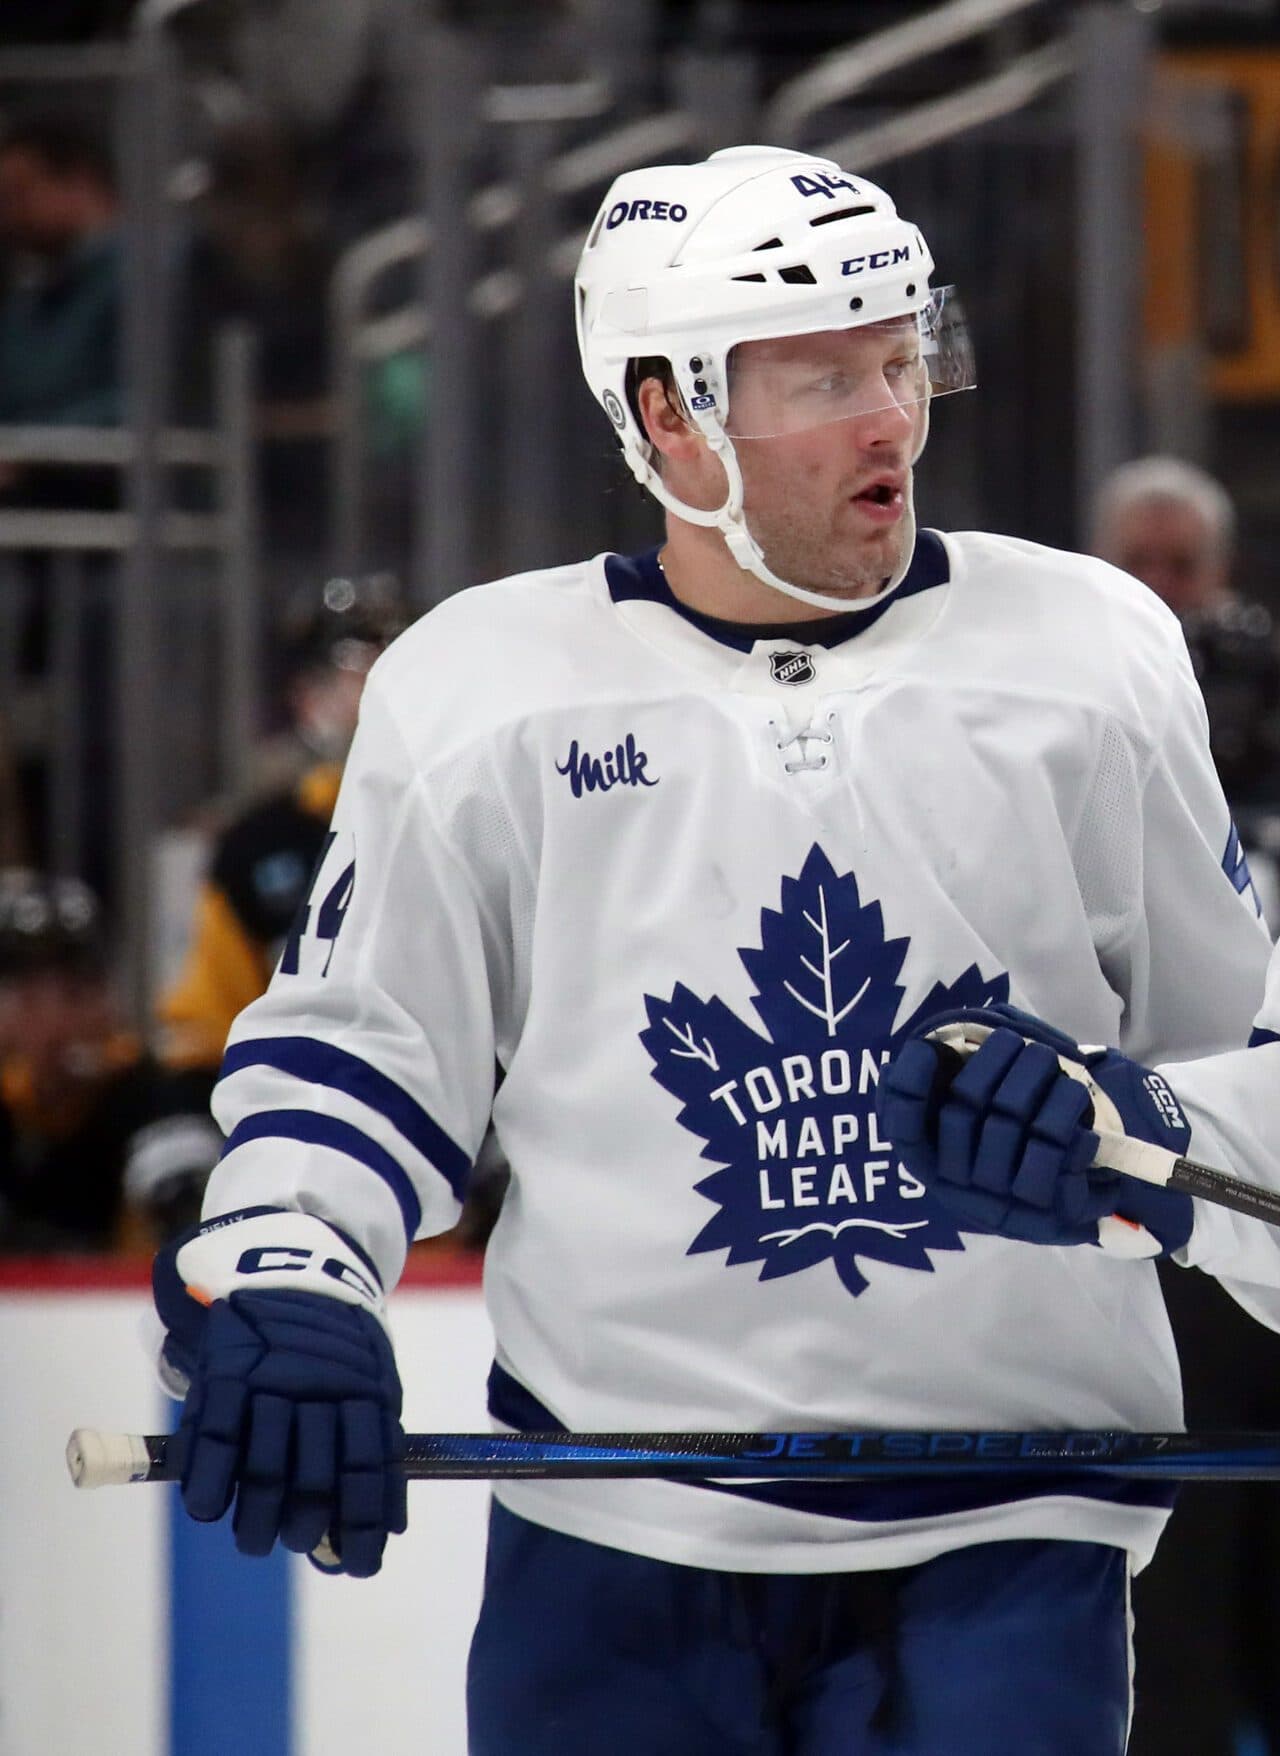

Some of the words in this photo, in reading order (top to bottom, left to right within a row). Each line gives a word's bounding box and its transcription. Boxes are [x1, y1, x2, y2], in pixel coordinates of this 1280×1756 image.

[606, 199, 688, 231] OREO
[840, 245, 910, 277] CCM
[779, 658, 807, 681] NHL
[554, 733, 661, 799] Milk
[709, 1048, 892, 1127] TORON
[1147, 1074, 1186, 1129] CCM
[755, 1112, 894, 1161] MAPL
[235, 1246, 378, 1305] CC
[740, 1433, 1112, 1460] JETSPEED
